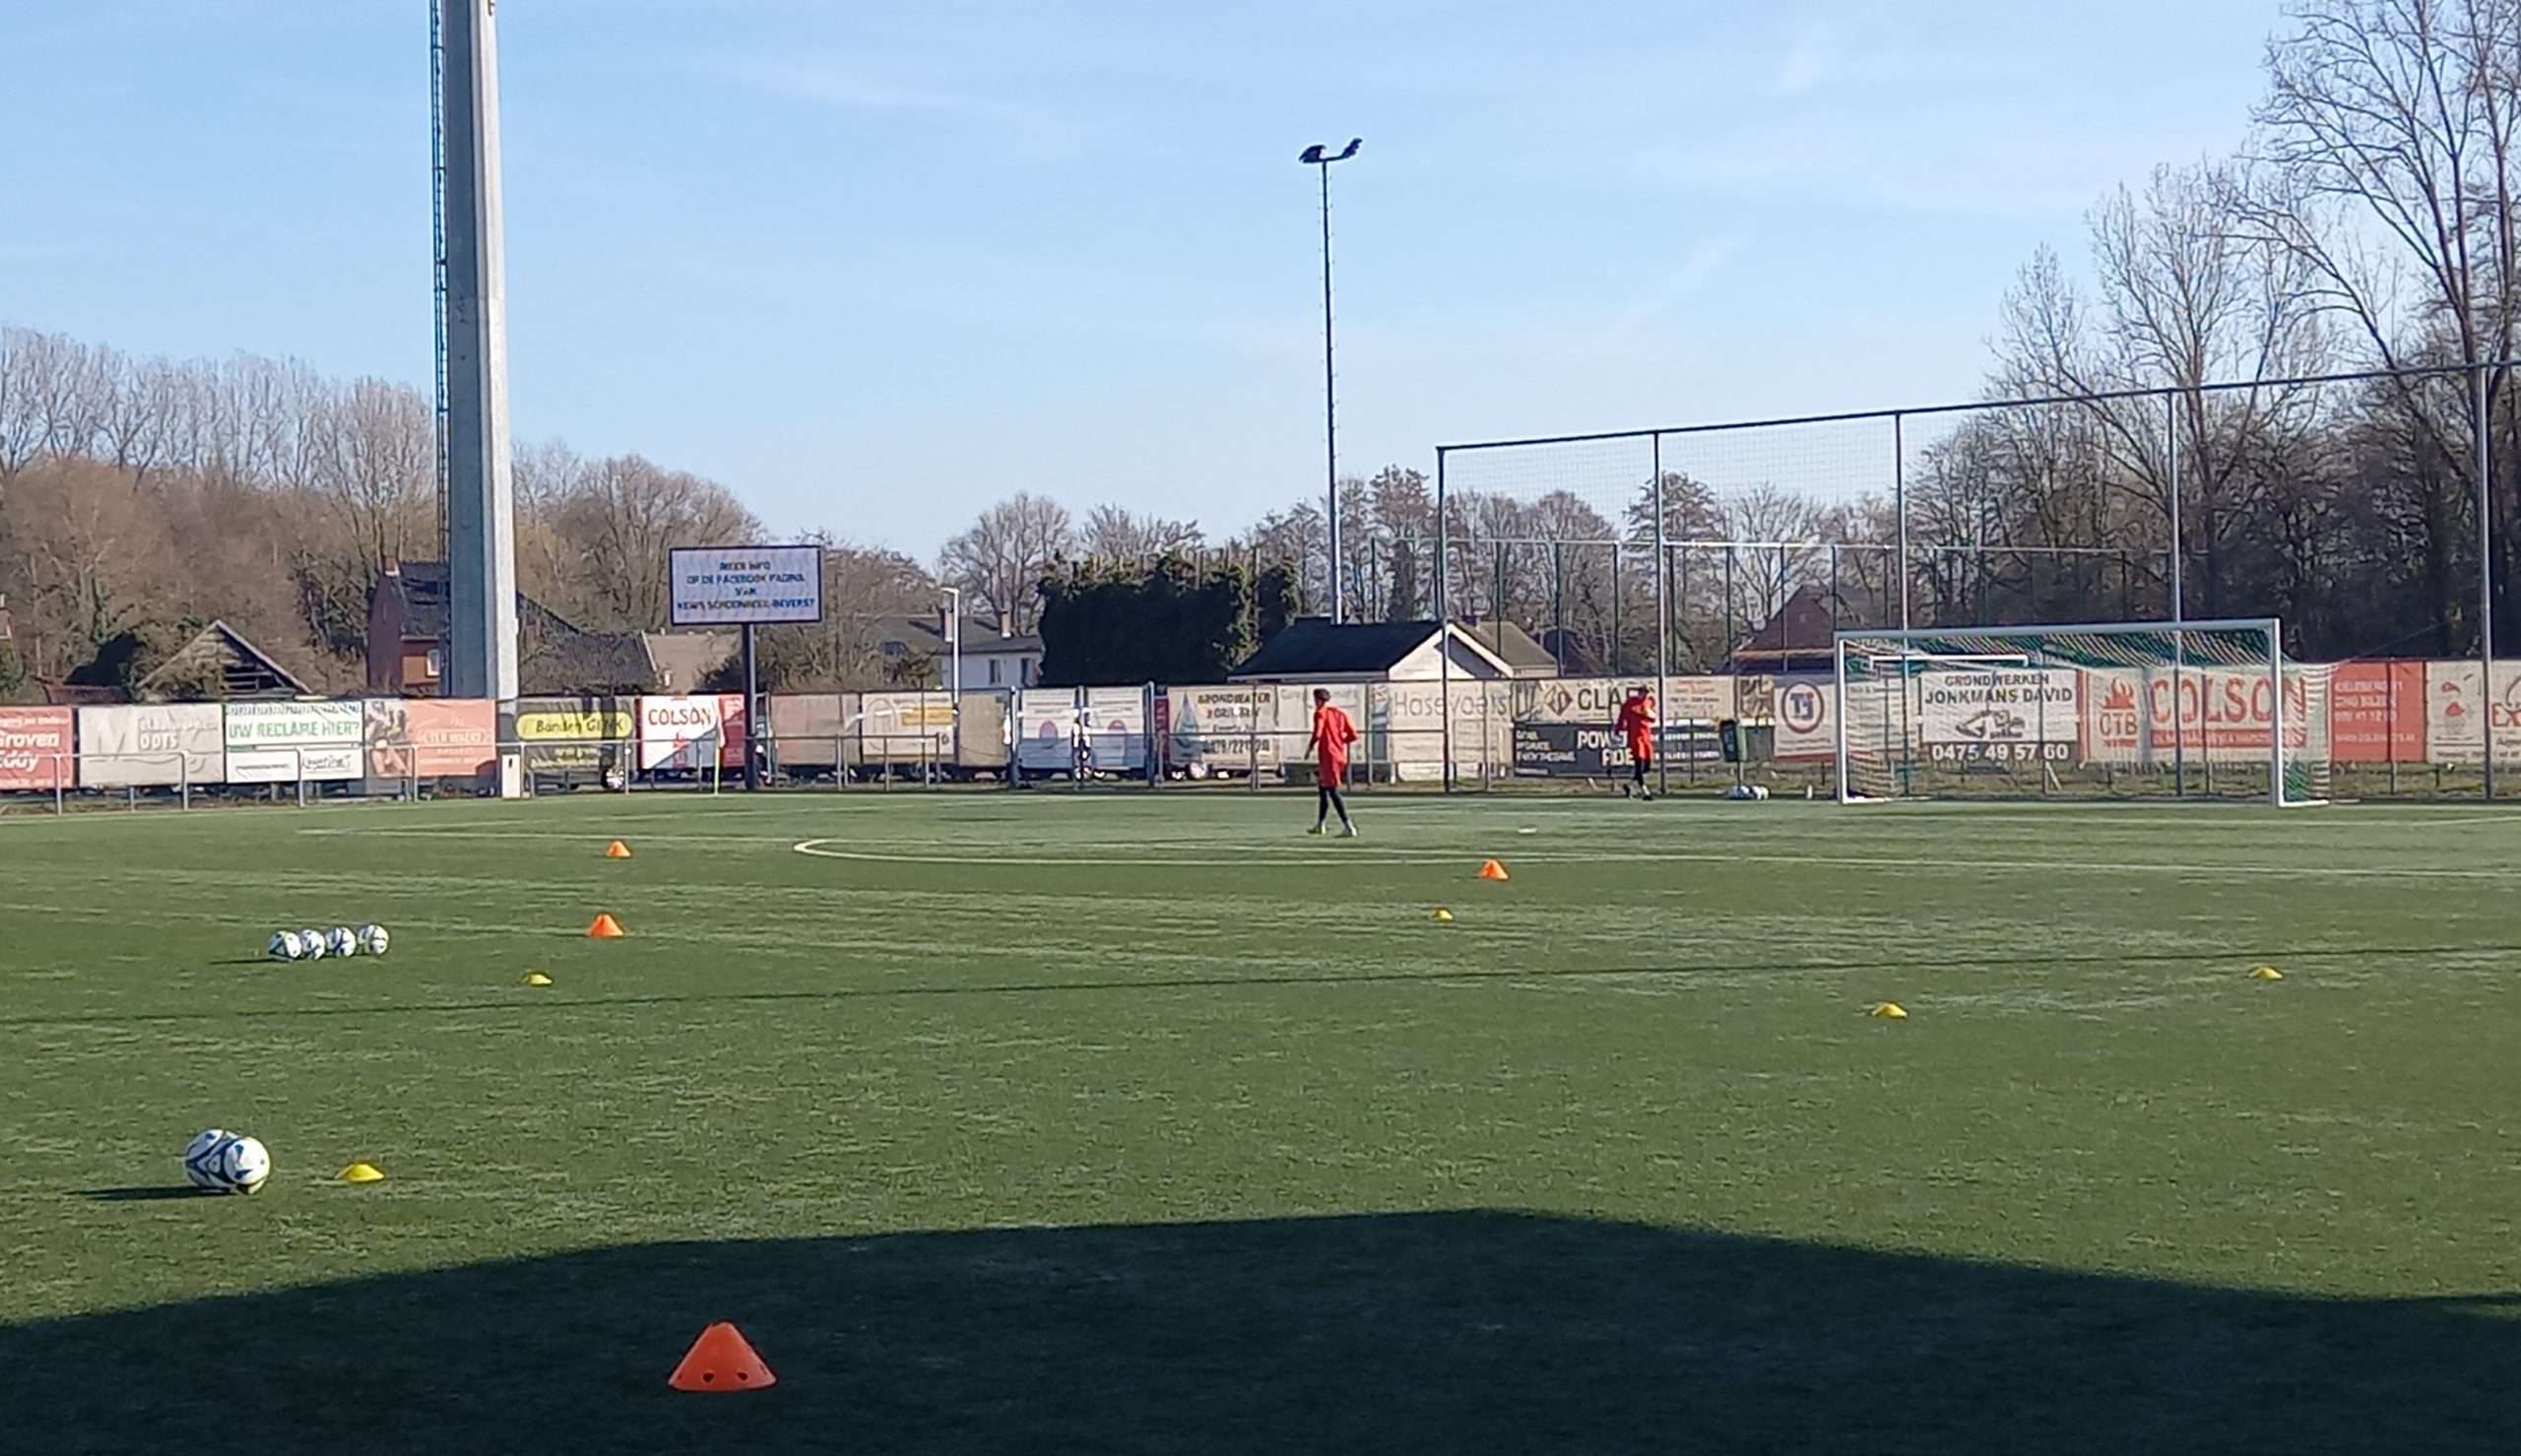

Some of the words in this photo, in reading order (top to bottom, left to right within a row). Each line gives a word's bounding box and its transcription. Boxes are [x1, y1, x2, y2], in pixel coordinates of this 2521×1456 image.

[1945, 673, 2049, 686] GRONDWERKEN
[1925, 687, 2018, 704] JONKMANS
[2023, 688, 2072, 702] DAVID
[2151, 677, 2306, 724] COLSON
[648, 708, 711, 726] COLSON
[2100, 713, 2138, 736] CTB
[228, 725, 252, 738] UW
[1932, 744, 1980, 760] 0475
[1984, 743, 2009, 760] 49
[2015, 744, 2036, 760] 57
[2043, 744, 2069, 759] 60
